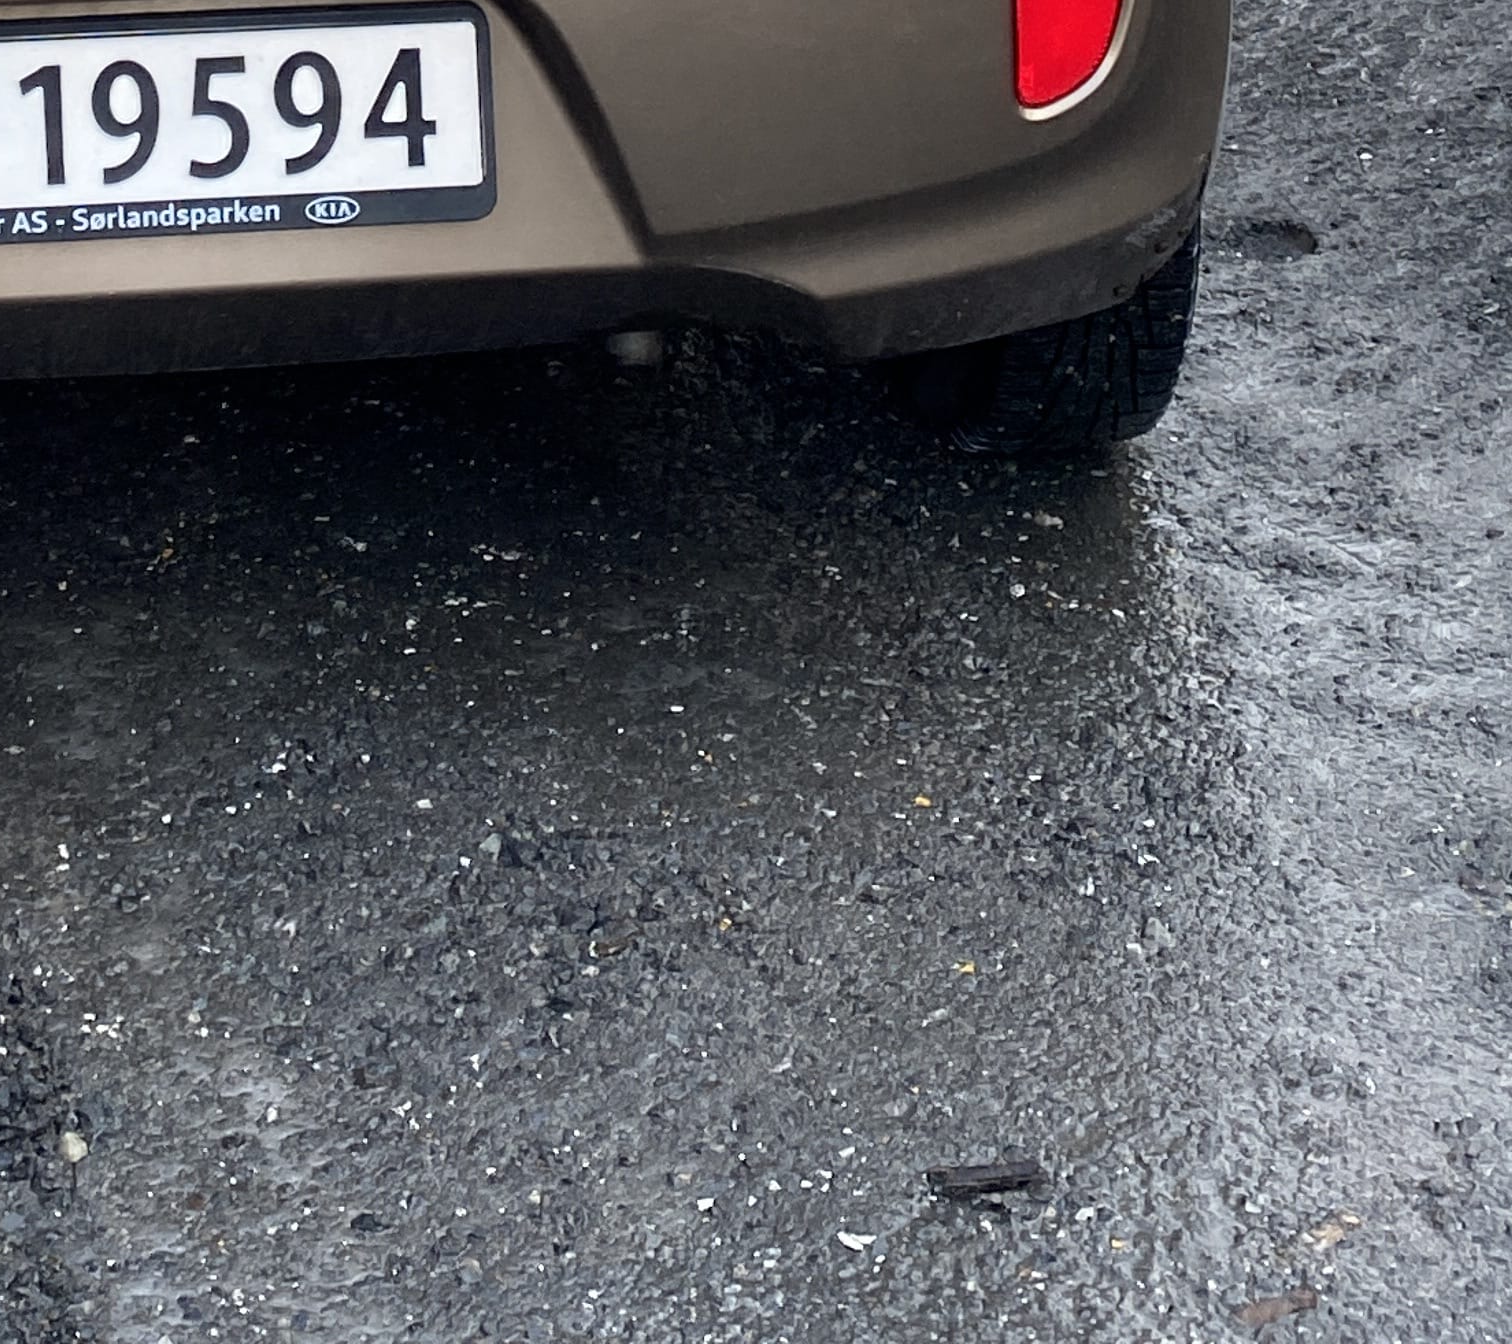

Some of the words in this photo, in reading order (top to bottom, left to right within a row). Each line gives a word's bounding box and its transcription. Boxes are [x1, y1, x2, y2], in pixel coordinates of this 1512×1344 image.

[19, 47, 438, 186] 19594
[12, 210, 49, 235] AS
[72, 200, 281, 231] Sørlandsparken
[314, 203, 352, 218] KIA
